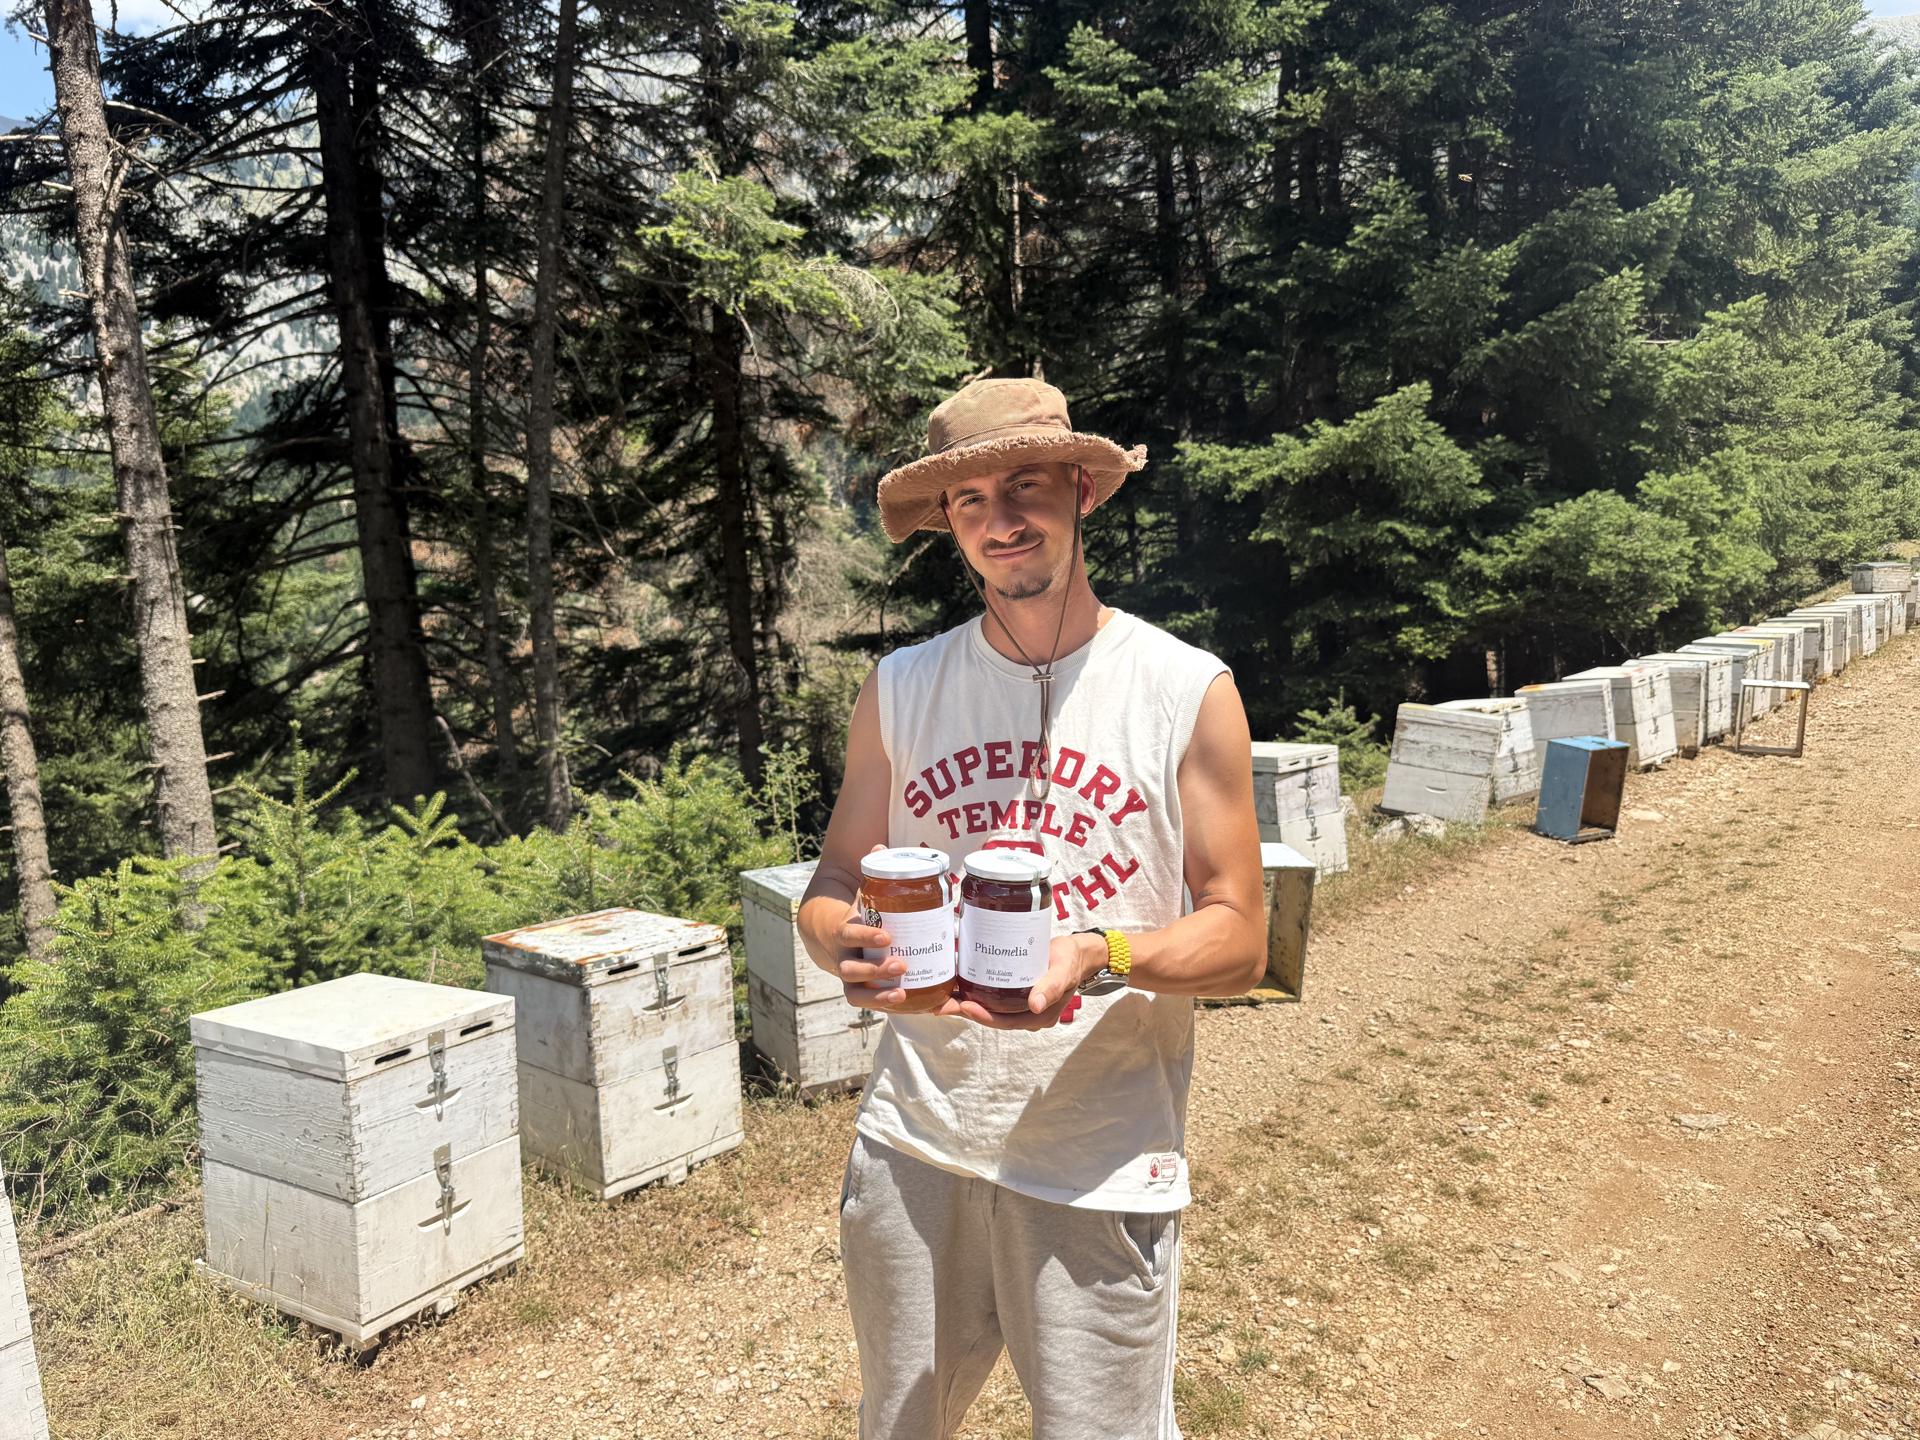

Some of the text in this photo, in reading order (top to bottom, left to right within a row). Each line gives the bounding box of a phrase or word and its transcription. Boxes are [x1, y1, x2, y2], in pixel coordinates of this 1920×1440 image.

[904, 740, 1148, 827] SUPERDRY
[937, 800, 1096, 848] TEMPLE
[1052, 853, 1140, 921] THL
[889, 943, 943, 957] Philomelia
[974, 942, 1028, 957] Philomelia
